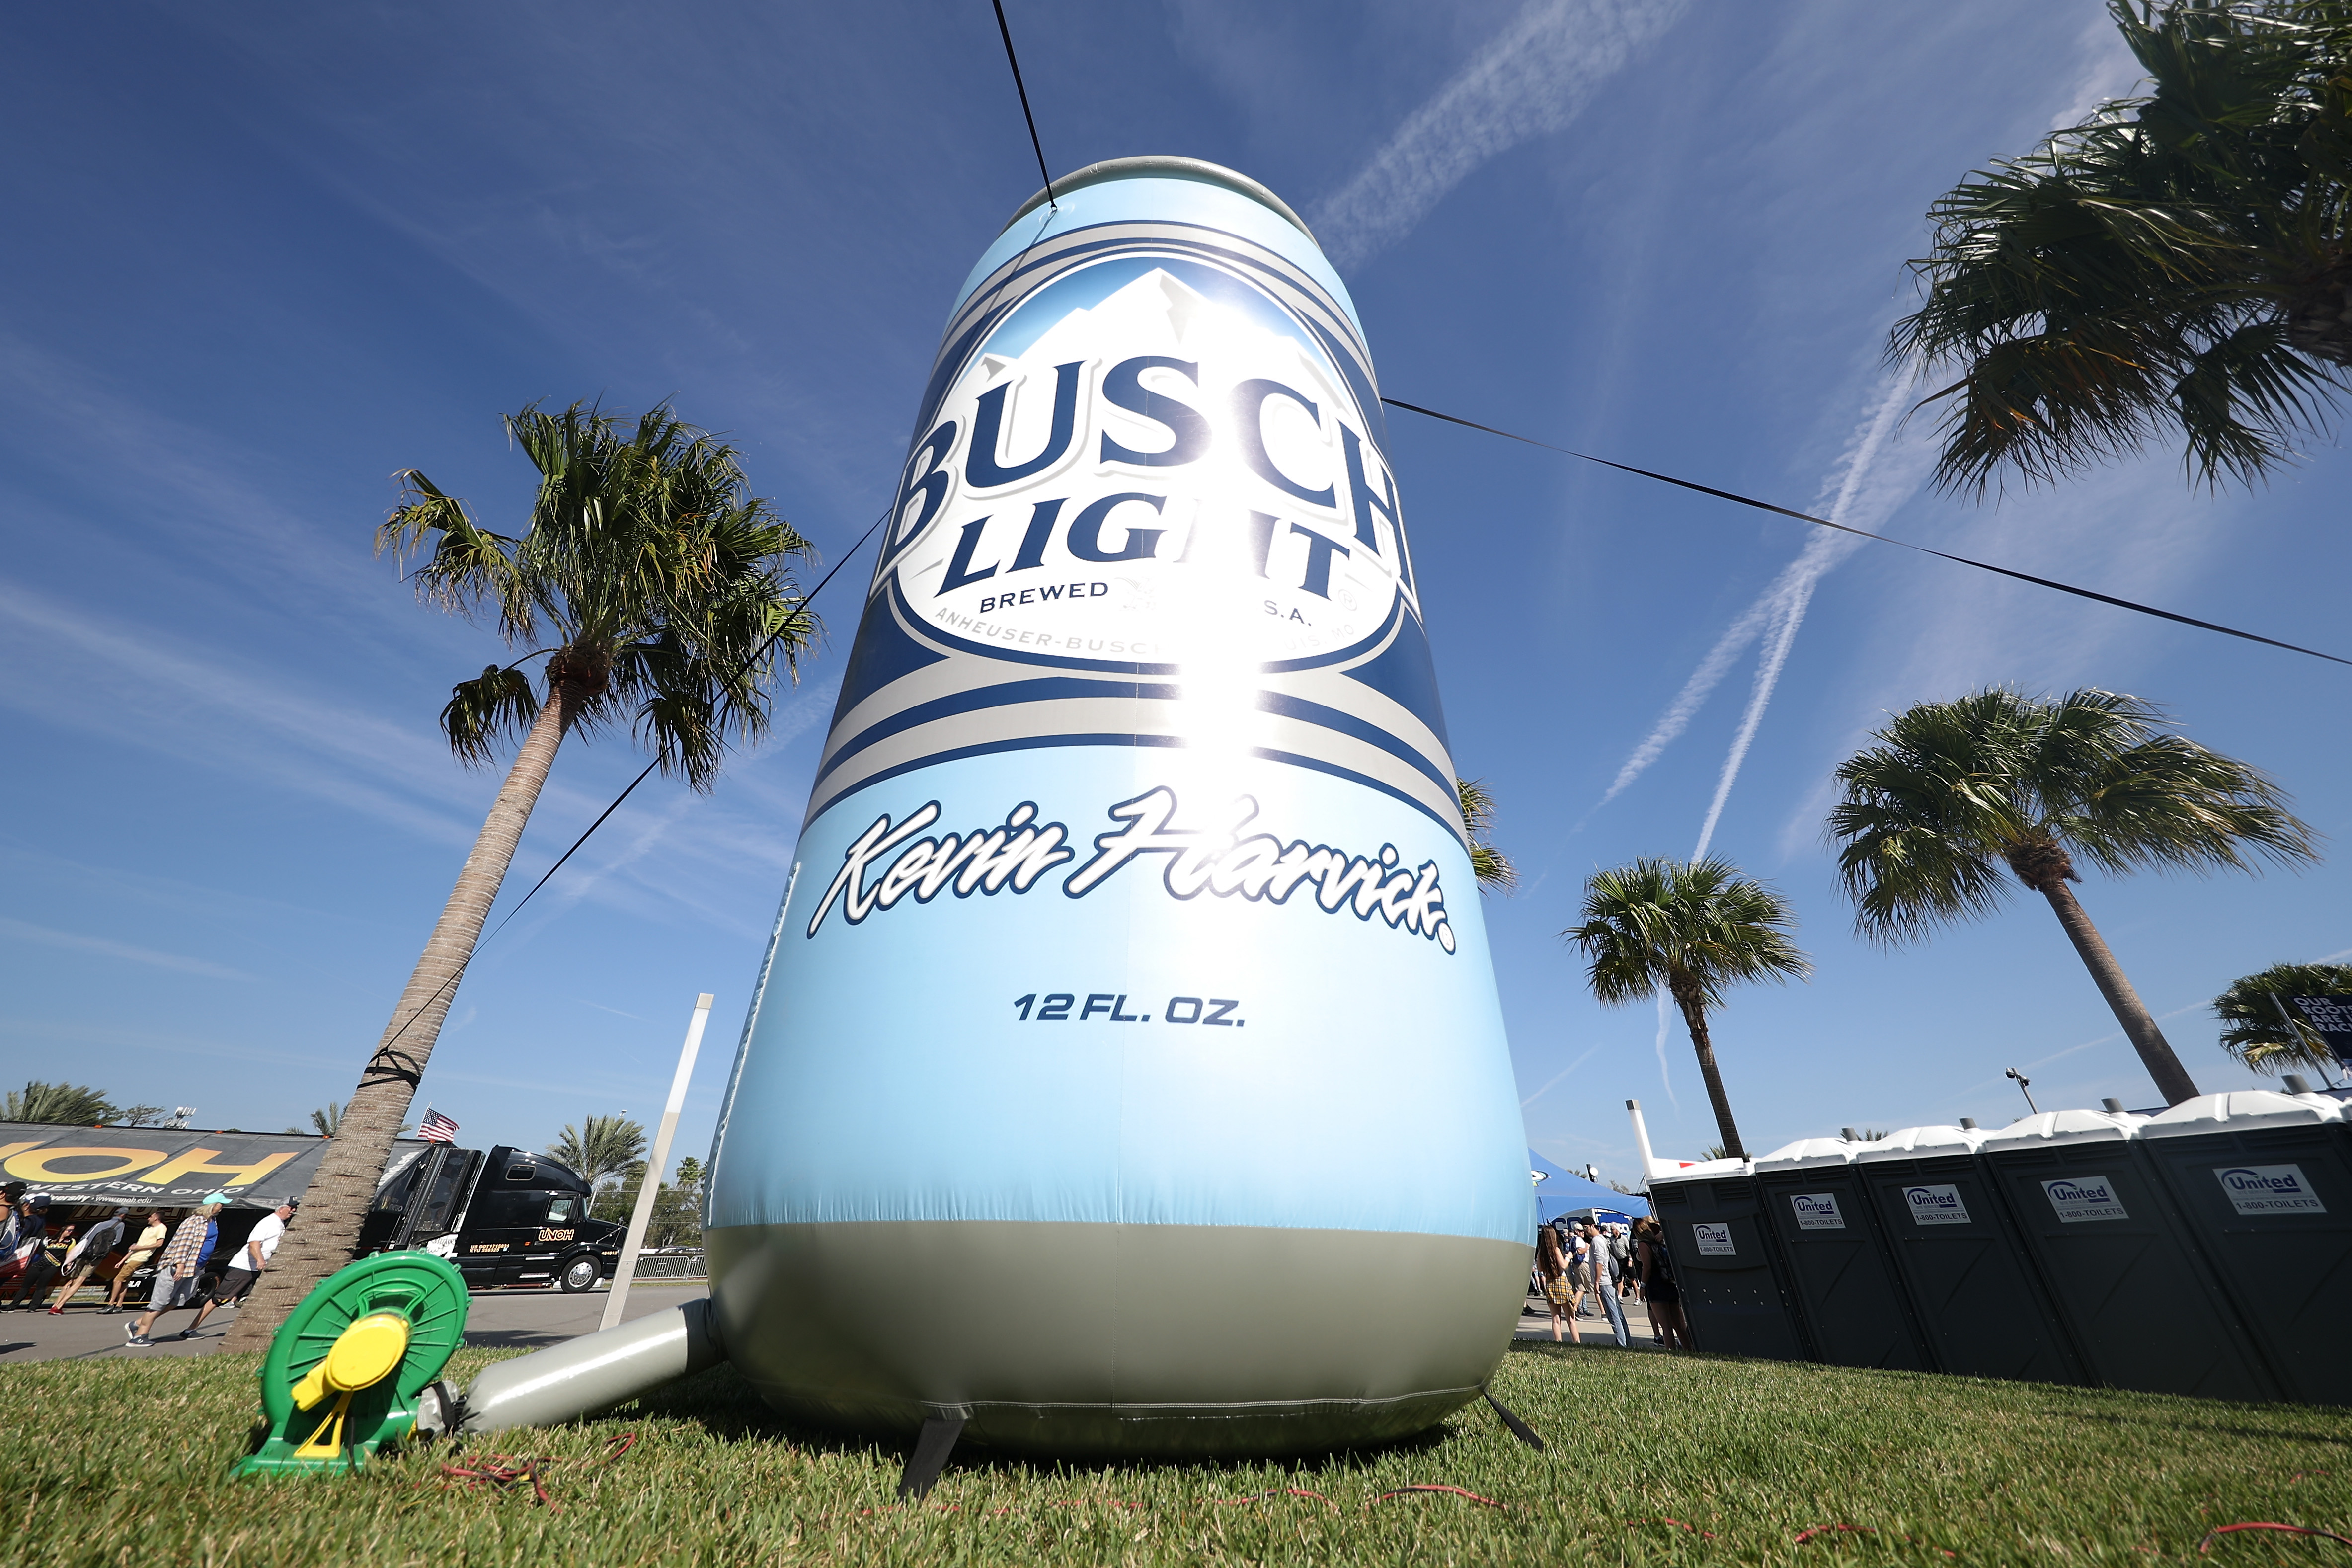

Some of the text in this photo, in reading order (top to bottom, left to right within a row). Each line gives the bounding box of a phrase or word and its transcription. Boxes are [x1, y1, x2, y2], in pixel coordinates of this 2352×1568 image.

[878, 355, 1413, 595] BUSCH
[979, 582, 1108, 614] BREWED
[807, 785, 1445, 941] Kevin Harvick
[2293, 997, 2334, 1006] OUR
[1014, 994, 1246, 1027] 12 FL. OZ.
[2311, 1014, 2343, 1023] ARE
[0, 1141, 299, 1186] OH
[2228, 1174, 2298, 1190] United
[1911, 1192, 1956, 1205] United
[2053, 1185, 2108, 1200] United
[95, 1195, 153, 1204] www.unoh.edu
[1797, 1200, 1833, 1211] United
[2236, 1199, 2319, 1210] 1-800-TOILETS
[2060, 1208, 2124, 1218] 1-800-TOILETS
[538, 1227, 575, 1241] UNOH
[1698, 1230, 1726, 1239] United
